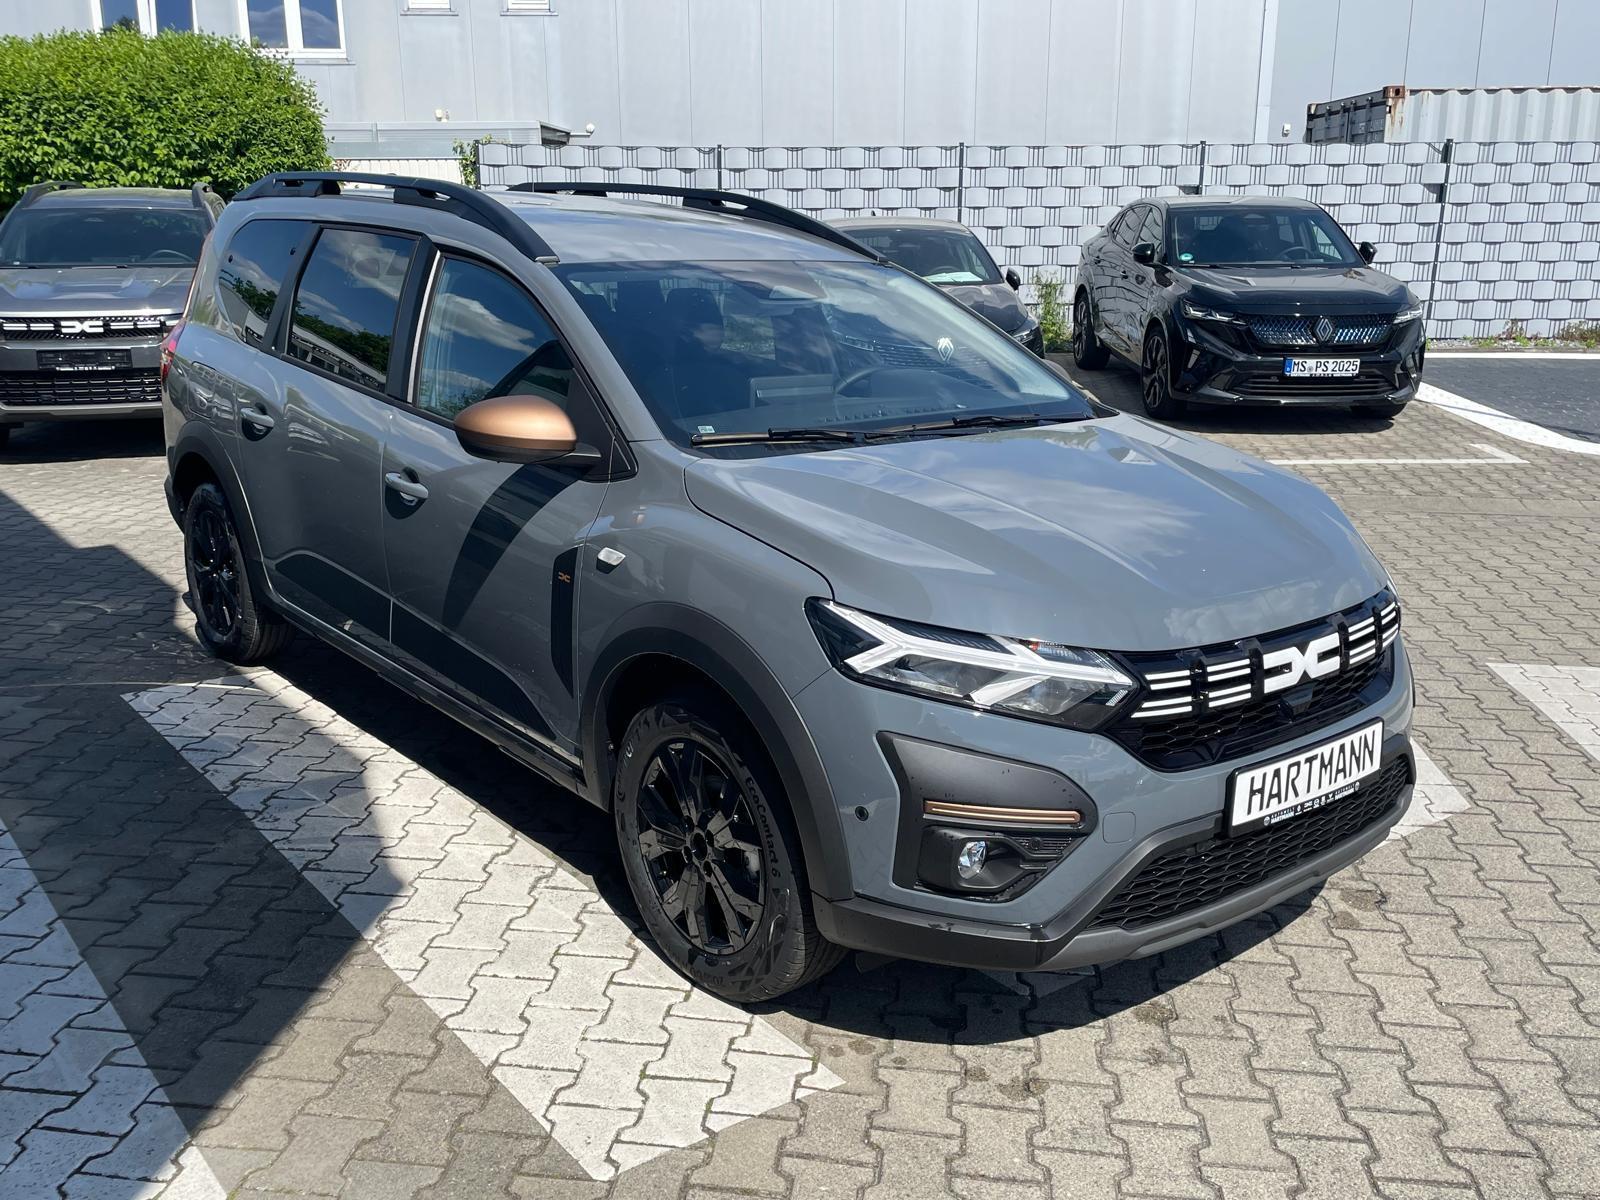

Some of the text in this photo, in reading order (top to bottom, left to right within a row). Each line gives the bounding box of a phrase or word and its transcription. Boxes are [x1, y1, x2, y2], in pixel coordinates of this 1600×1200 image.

[1292, 360, 1307, 372] MS
[1315, 360, 1329, 372] PS
[1331, 360, 1359, 372] 2025
[1247, 729, 1376, 816] HARTMANN
[745, 776, 781, 878] EcoContact 6
